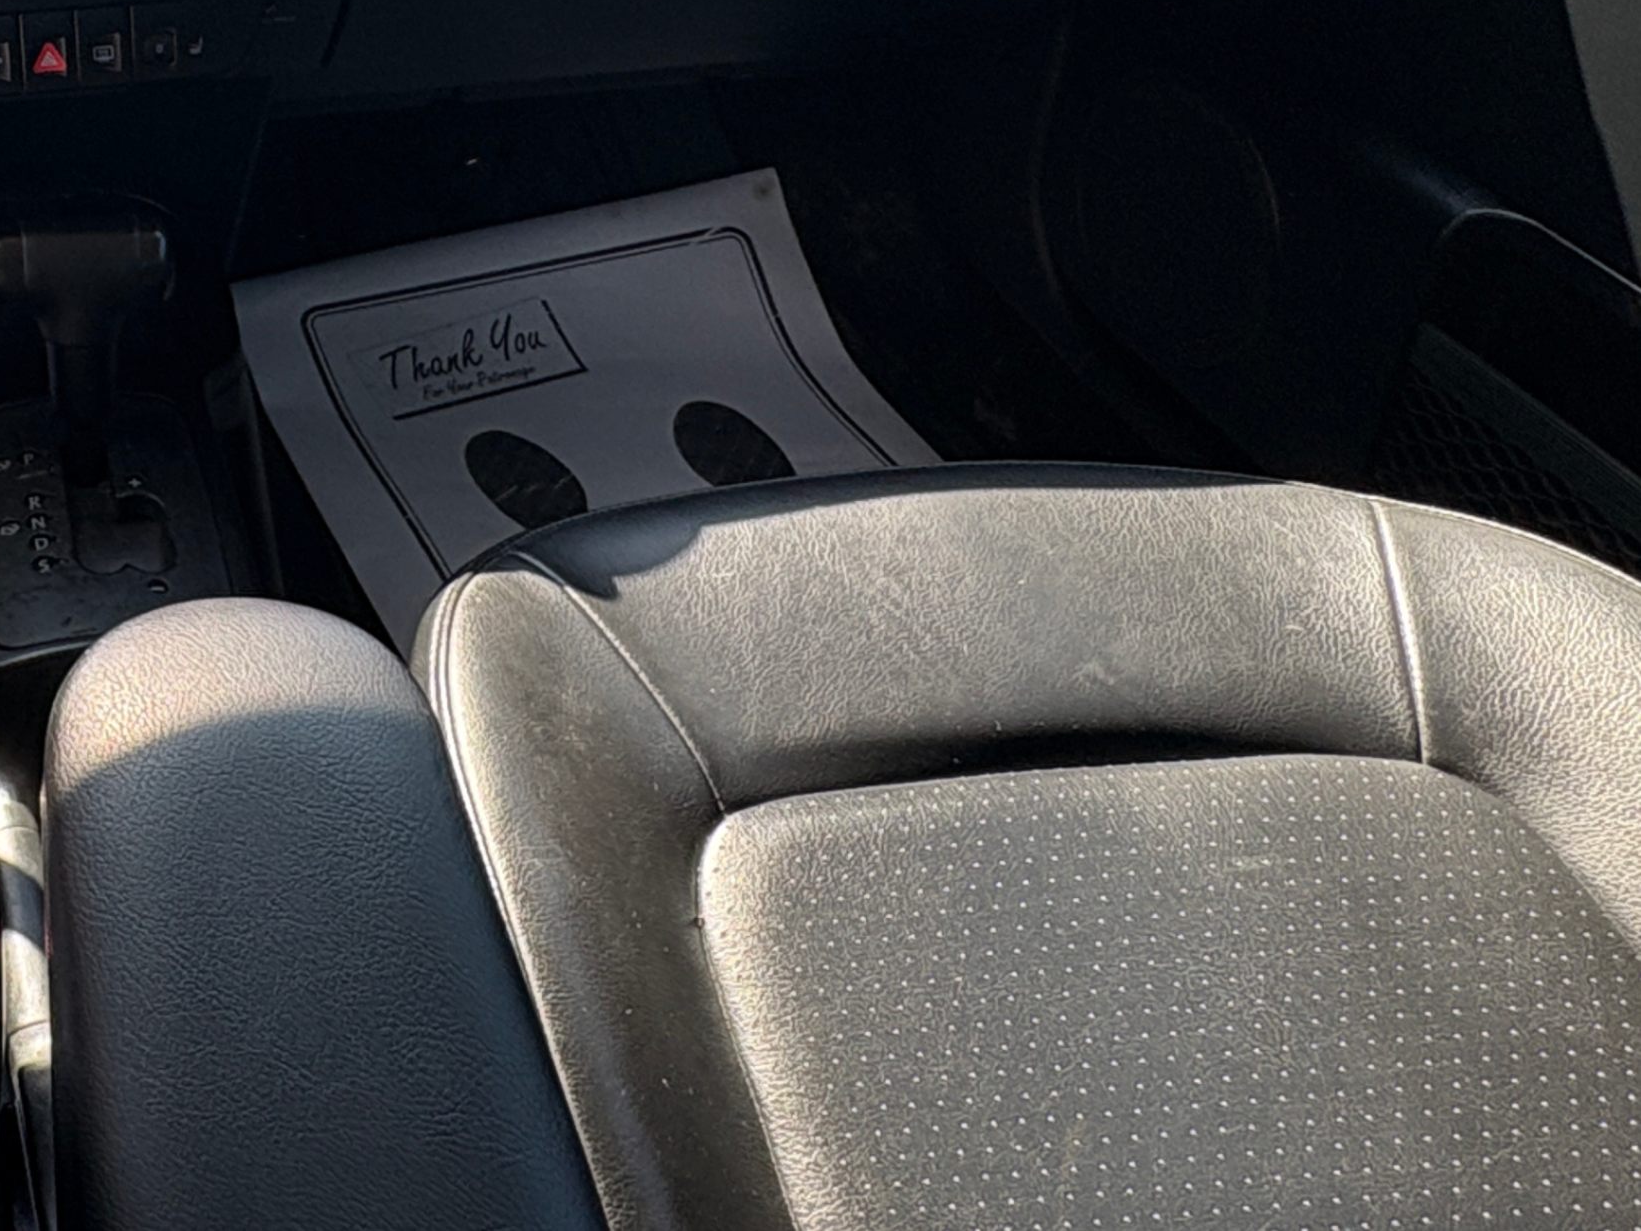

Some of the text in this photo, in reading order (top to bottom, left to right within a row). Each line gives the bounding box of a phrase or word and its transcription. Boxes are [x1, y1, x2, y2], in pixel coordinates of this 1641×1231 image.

[379, 313, 546, 390] Thank You
[23, 452, 35, 465] P
[28, 495, 42, 510] R
[30, 516, 46, 530] N
[34, 538, 49, 552] D
[38, 559, 51, 574] S
